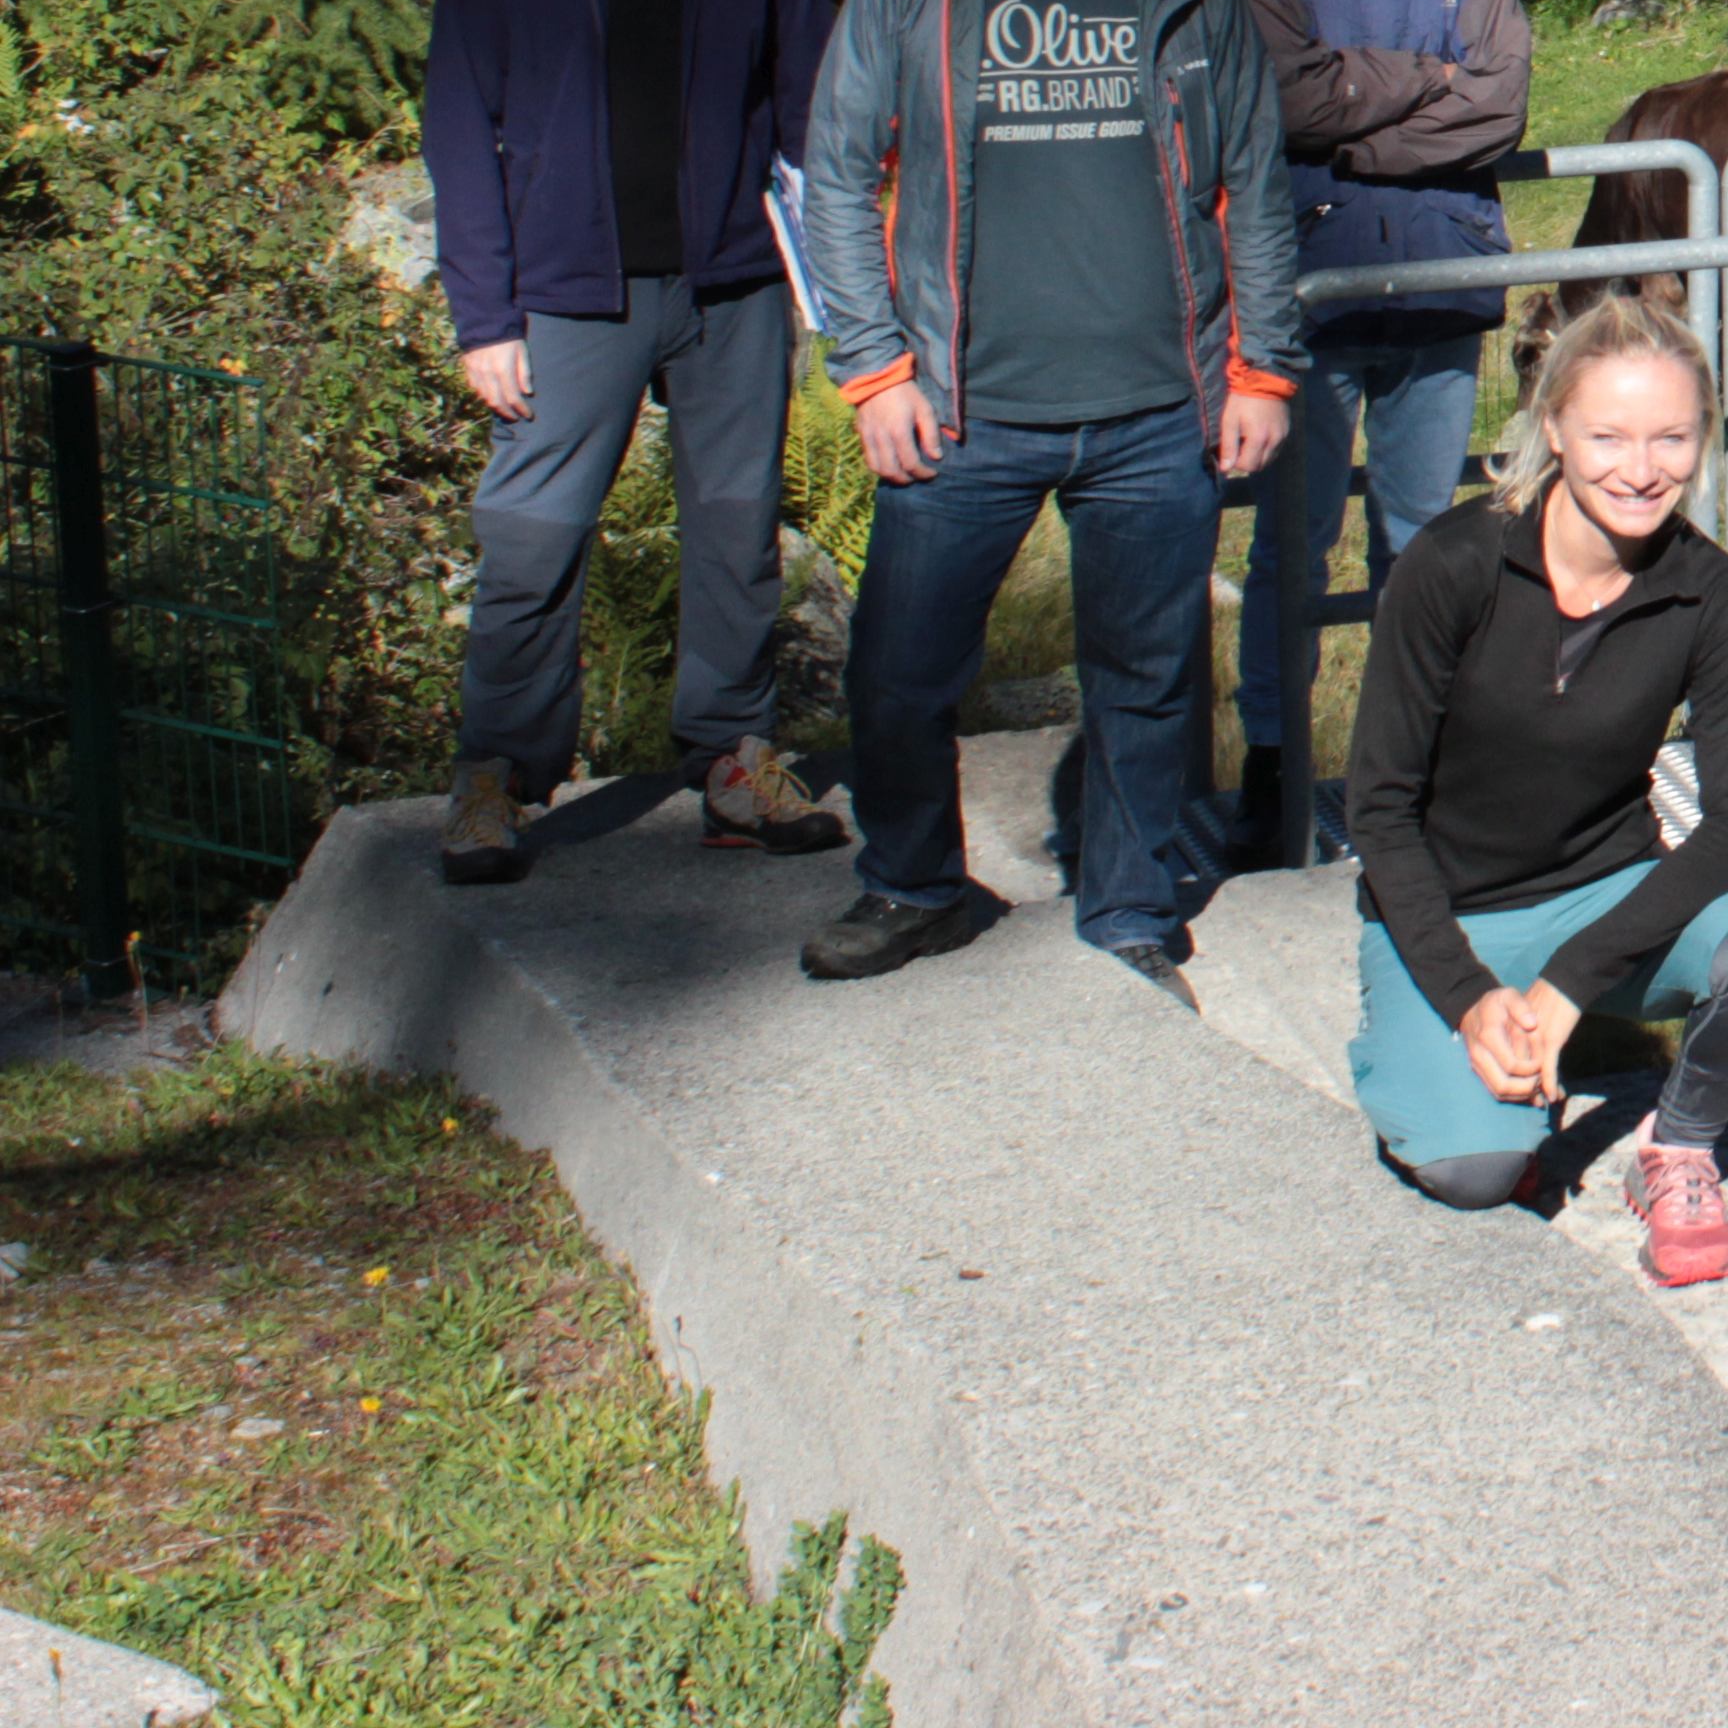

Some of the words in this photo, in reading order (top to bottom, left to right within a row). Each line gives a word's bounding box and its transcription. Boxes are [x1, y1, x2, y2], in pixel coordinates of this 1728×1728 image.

[984, 124, 1053, 142] PREMIUM
[1056, 123, 1097, 140] ISSUE
[1099, 121, 1144, 138] GOODS
